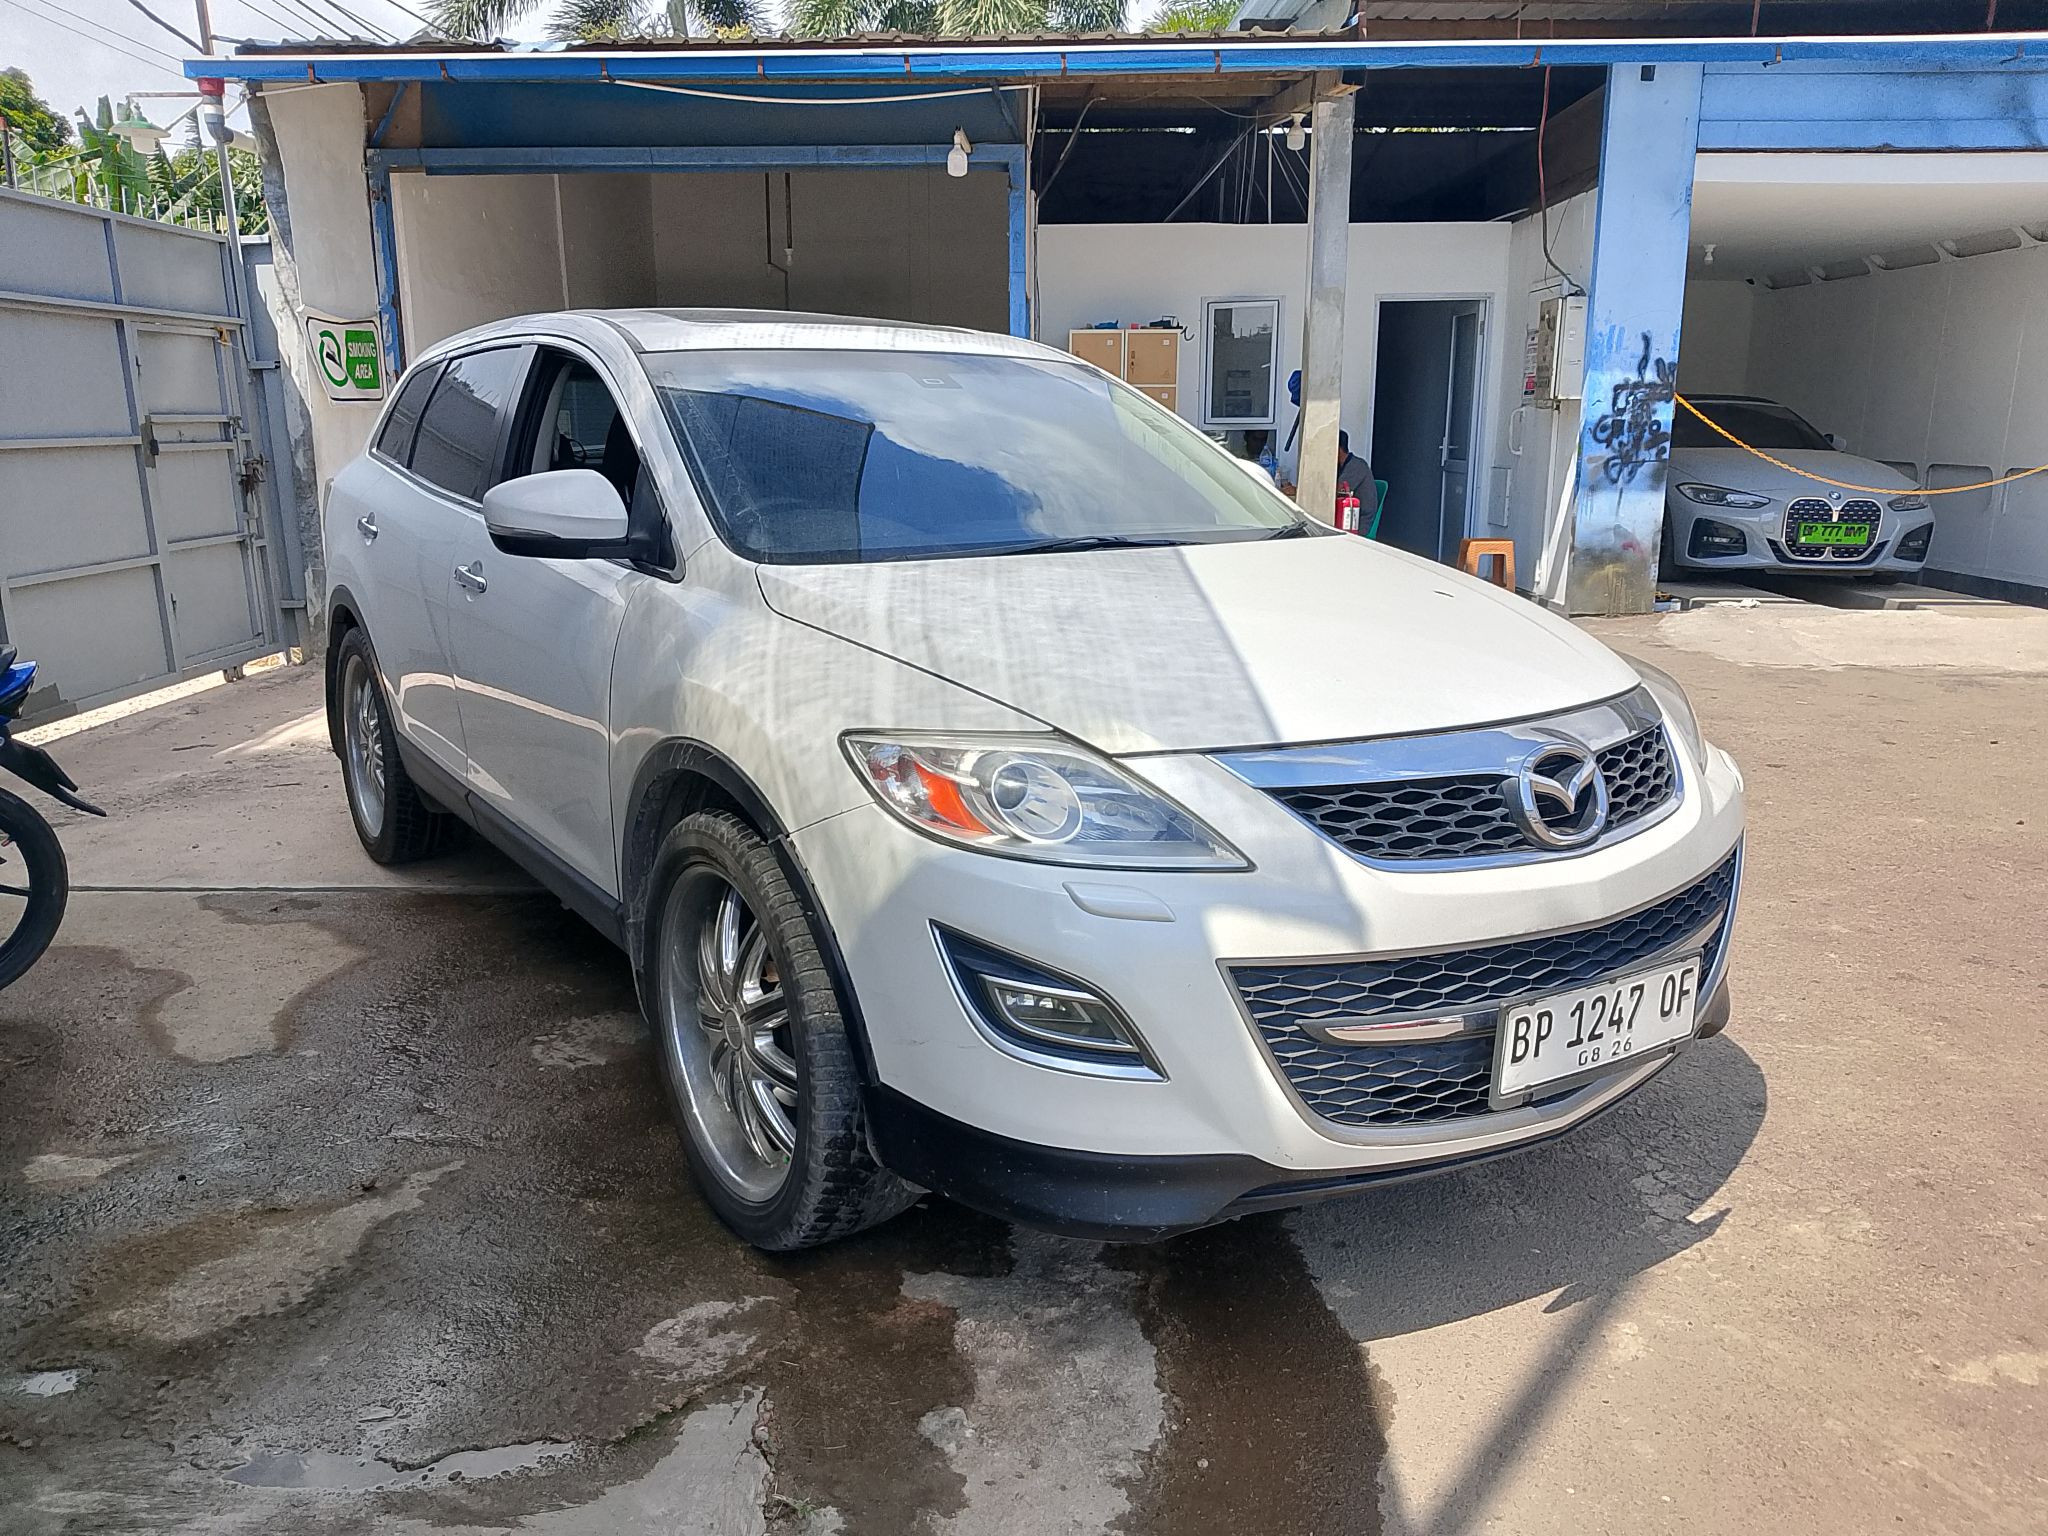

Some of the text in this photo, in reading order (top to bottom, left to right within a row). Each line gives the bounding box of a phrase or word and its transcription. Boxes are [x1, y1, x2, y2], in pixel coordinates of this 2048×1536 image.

[348, 343, 376, 358] SMOKING
[355, 364, 374, 379] AREA
[1821, 525, 1842, 537] 777
[1511, 967, 1694, 1064] BP 1247 OF
[1611, 1037, 1632, 1056] 26
